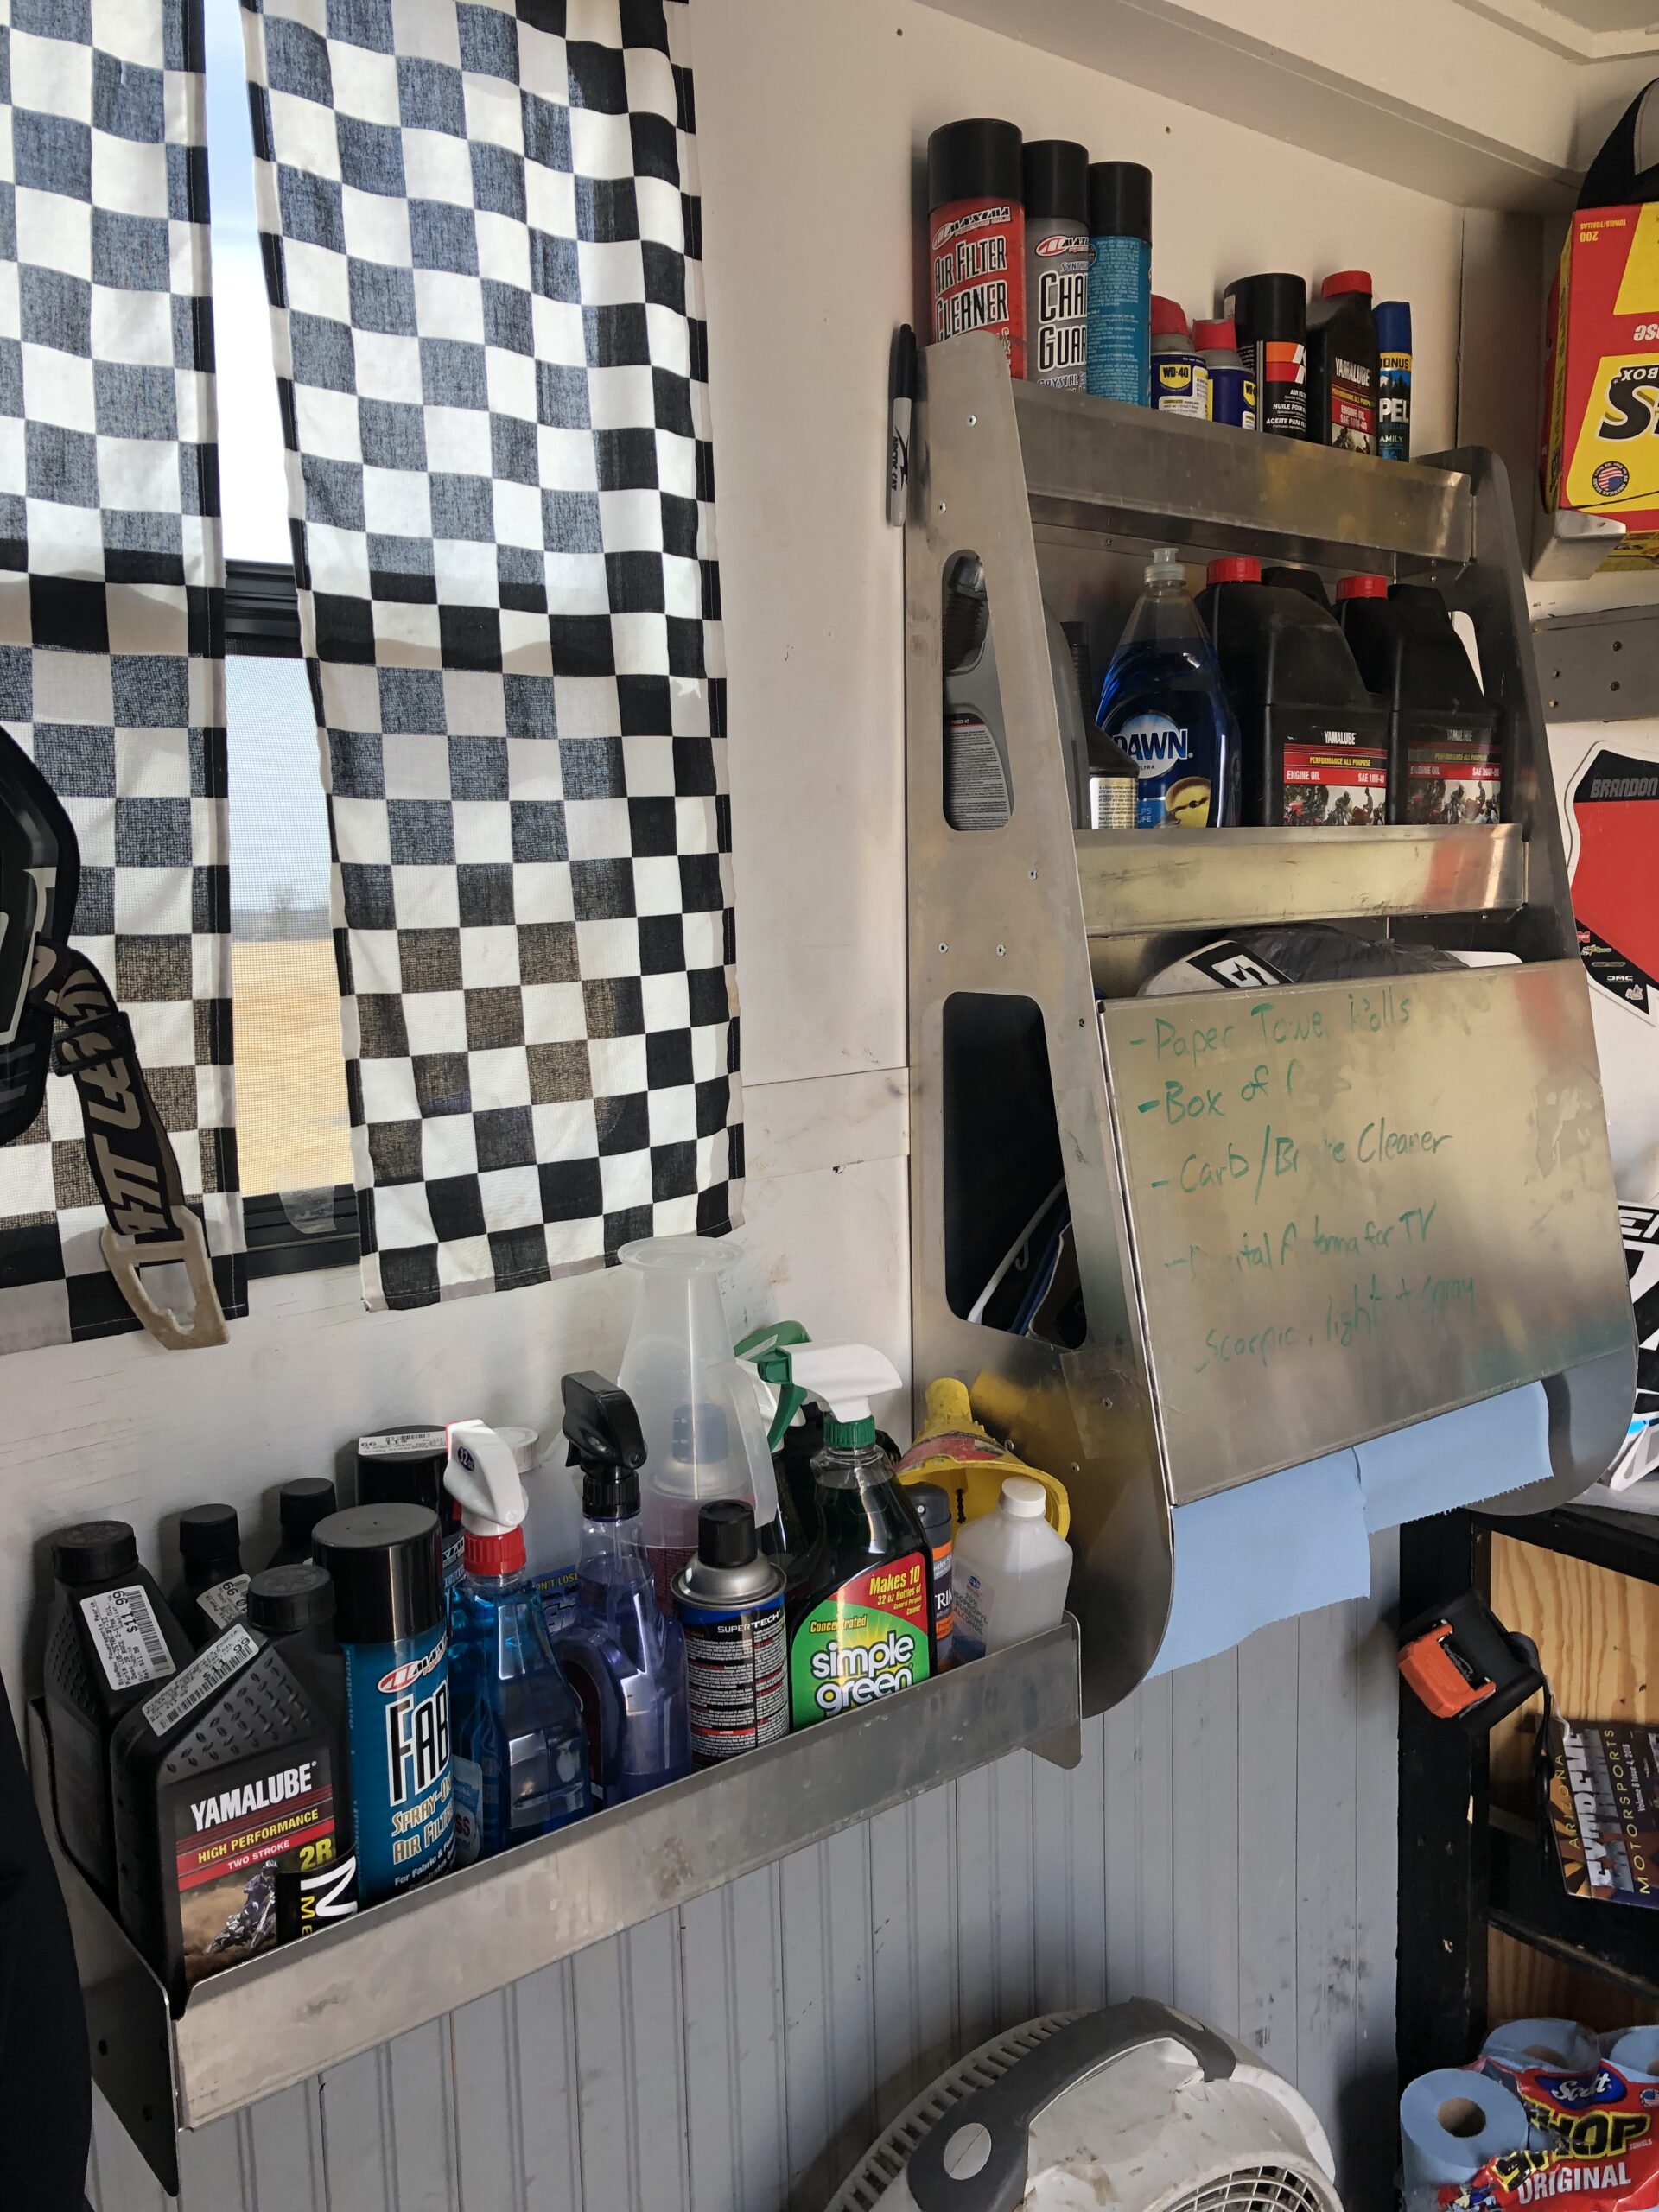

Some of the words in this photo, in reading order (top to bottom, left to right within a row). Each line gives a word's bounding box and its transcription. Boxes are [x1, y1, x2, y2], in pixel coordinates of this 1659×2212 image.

[1580, 231, 1599, 243] 200
[935, 253, 955, 297] AIR
[956, 236, 1007, 283] FILTER
[936, 280, 1009, 343] CLEANER
[1039, 270, 1088, 324] CHA
[1162, 367, 1189, 378] WD-40
[1335, 357, 1370, 387] YAMALUBE
[1379, 398, 1409, 423] PEL
[1379, 435, 1403, 443] AMILY
[1112, 729, 1188, 760] DAWN
[1324, 731, 1356, 745] YAMALUBE
[1287, 771, 1310, 780] ENGINE
[1311, 771, 1320, 780] OIL
[1357, 773, 1368, 782] SAE
[1472, 767, 1482, 776] SAE
[1590, 777, 1658, 799] BRANDON
[1398, 1201, 1437, 1244] TV
[869, 1572, 906, 1595] Makes
[909, 1565, 920, 1585] 10
[877, 1595, 886, 1605] 32
[896, 1587, 915, 1601] Bottles
[916, 1583, 921, 1594] of
[810, 1614, 868, 1633] Concentrated
[810, 1630, 915, 1679] simple
[816, 1666, 913, 1717] green
[1630, 1765, 1639, 1783] Issue
[190, 1763, 313, 1832] YAMALUBE
[1554, 1754, 1581, 1849] ARIZONA
[1605, 1729, 1651, 1895] MOTORSPORTS
[198, 1844, 227, 1864] HIGH
[231, 1808, 319, 1851] PERFORMANCE
[227, 1856, 250, 1871] TWO
[252, 1840, 290, 1860] STROKE
[299, 1838, 333, 1871] 2R
[393, 1838, 421, 1866] AIR
[395, 1872, 410, 1886] For
[412, 1856, 437, 1881] Fabric
[1552, 2072, 1612, 2101] Scott
[1517, 2161, 1632, 2205] ORIGINAL
